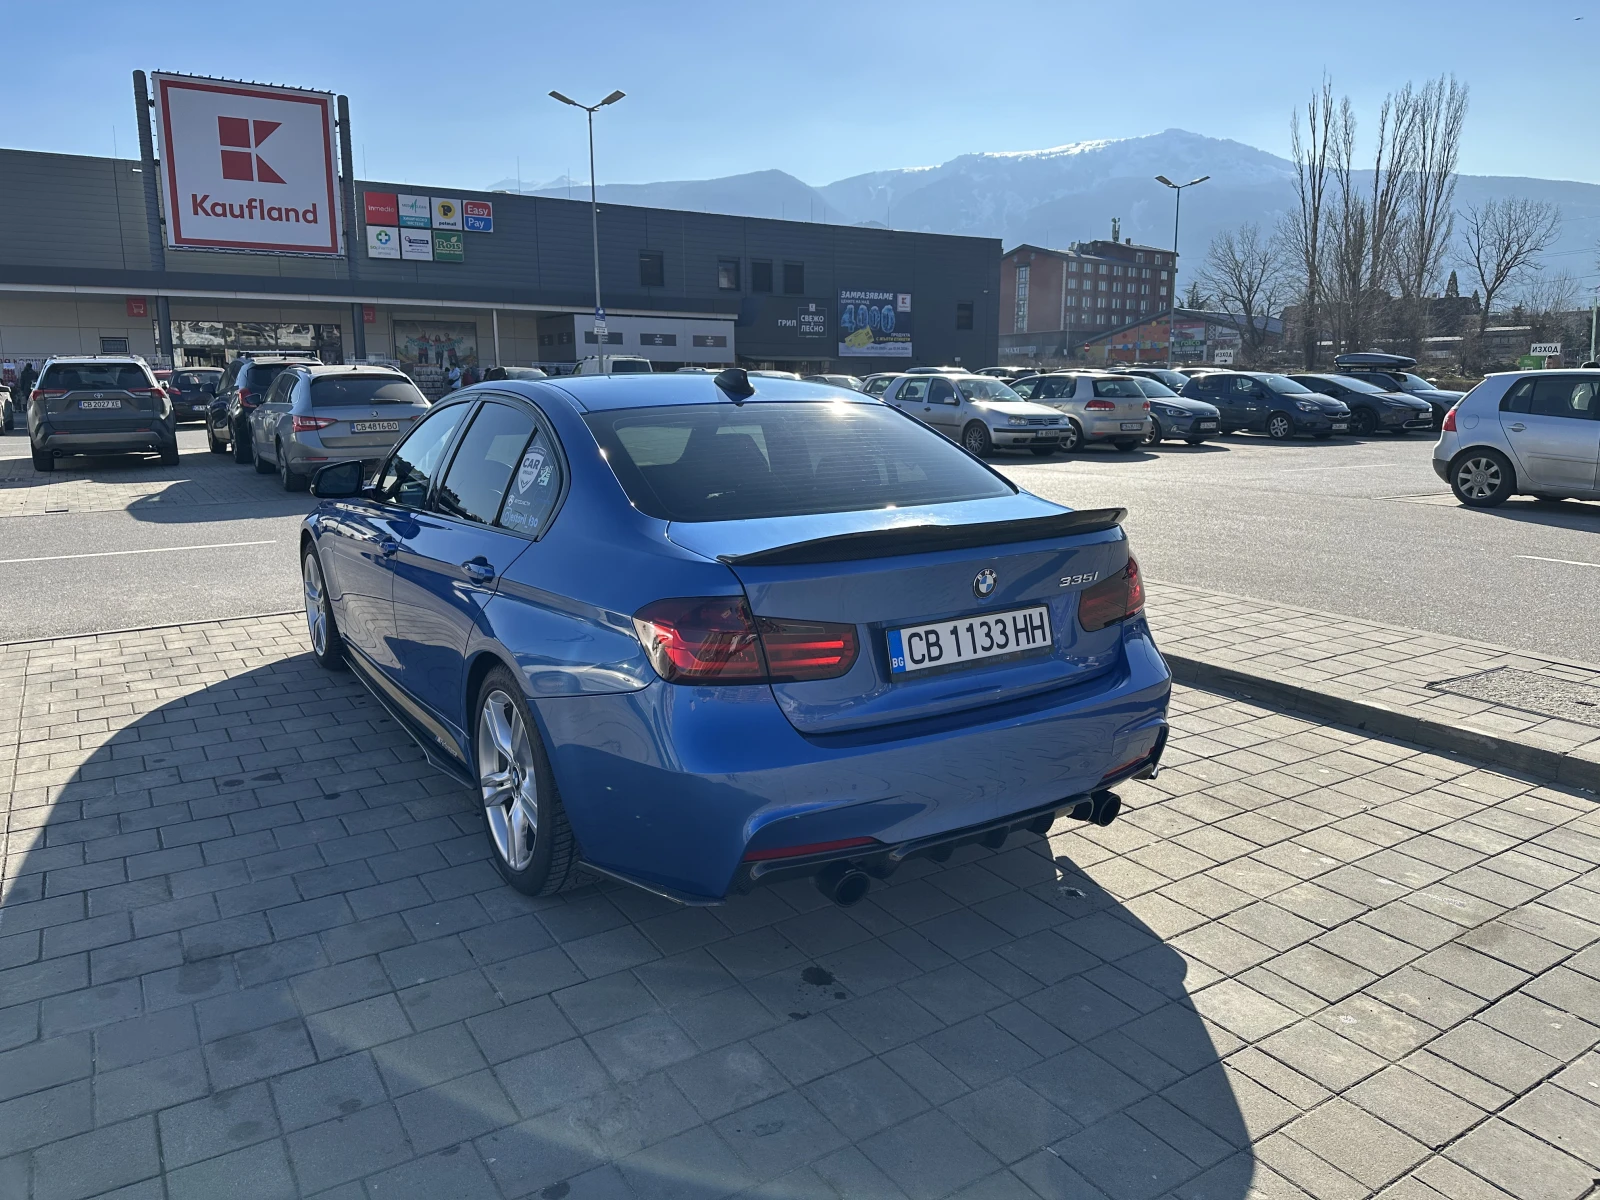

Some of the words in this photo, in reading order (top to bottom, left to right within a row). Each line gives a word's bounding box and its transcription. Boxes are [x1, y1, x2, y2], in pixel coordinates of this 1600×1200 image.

[191, 193, 318, 224] Kaufland
[467, 204, 489, 217] Easy
[468, 217, 485, 229] Pay
[436, 238, 462, 251] Rois
[840, 290, 894, 300] ЗАМРАЗЯВАМЕ
[777, 319, 797, 327] ГРИЛ
[800, 314, 824, 323] СВЕЖО
[840, 304, 896, 334] 4000
[800, 325, 824, 333] ЛЕСНО
[1532, 345, 1559, 354] ИЗХОД
[1215, 351, 1233, 359] ИЗХОД
[82, 401, 92, 409] CB
[93, 401, 109, 409] 2027
[355, 423, 367, 431] CB
[367, 422, 386, 431] 4816
[522, 457, 541, 470] CAR
[907, 629, 944, 665] CB
[950, 618, 1010, 657] 1133
[1012, 611, 1047, 647] HH
[892, 657, 904, 668] BG
